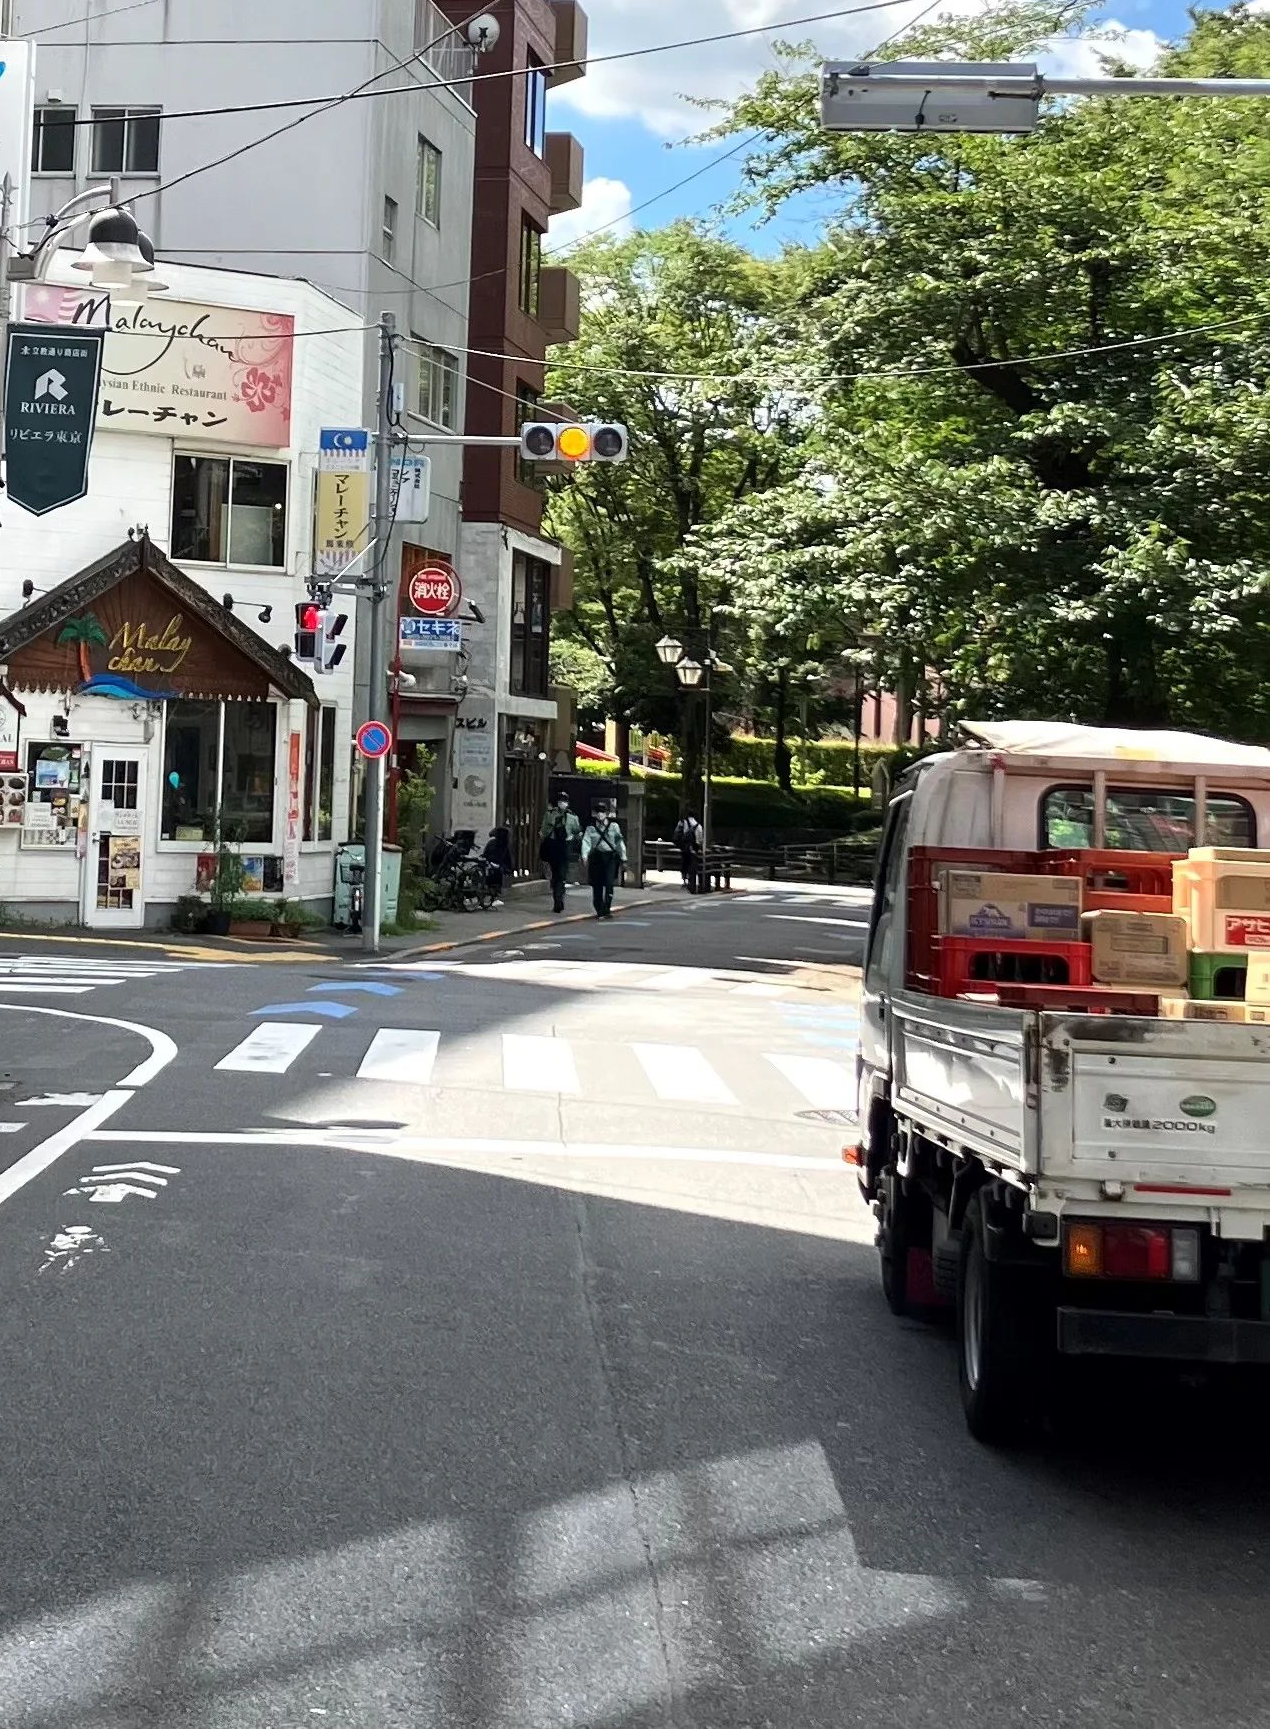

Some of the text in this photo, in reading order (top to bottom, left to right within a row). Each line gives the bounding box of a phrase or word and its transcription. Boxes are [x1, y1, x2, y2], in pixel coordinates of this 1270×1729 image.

[132, 379, 165, 394] Ethnic
[171, 383, 228, 401] Restaurant
[20, 401, 76, 415] RIVIERA
[102, 399, 228, 427] レーチャン
[10, 428, 83, 444] リビエラ東京
[333, 473, 350, 539] マレーチャン
[414, 581, 450, 600] 消火栓
[417, 620, 460, 635] セキネ
[108, 614, 192, 672] Malay
